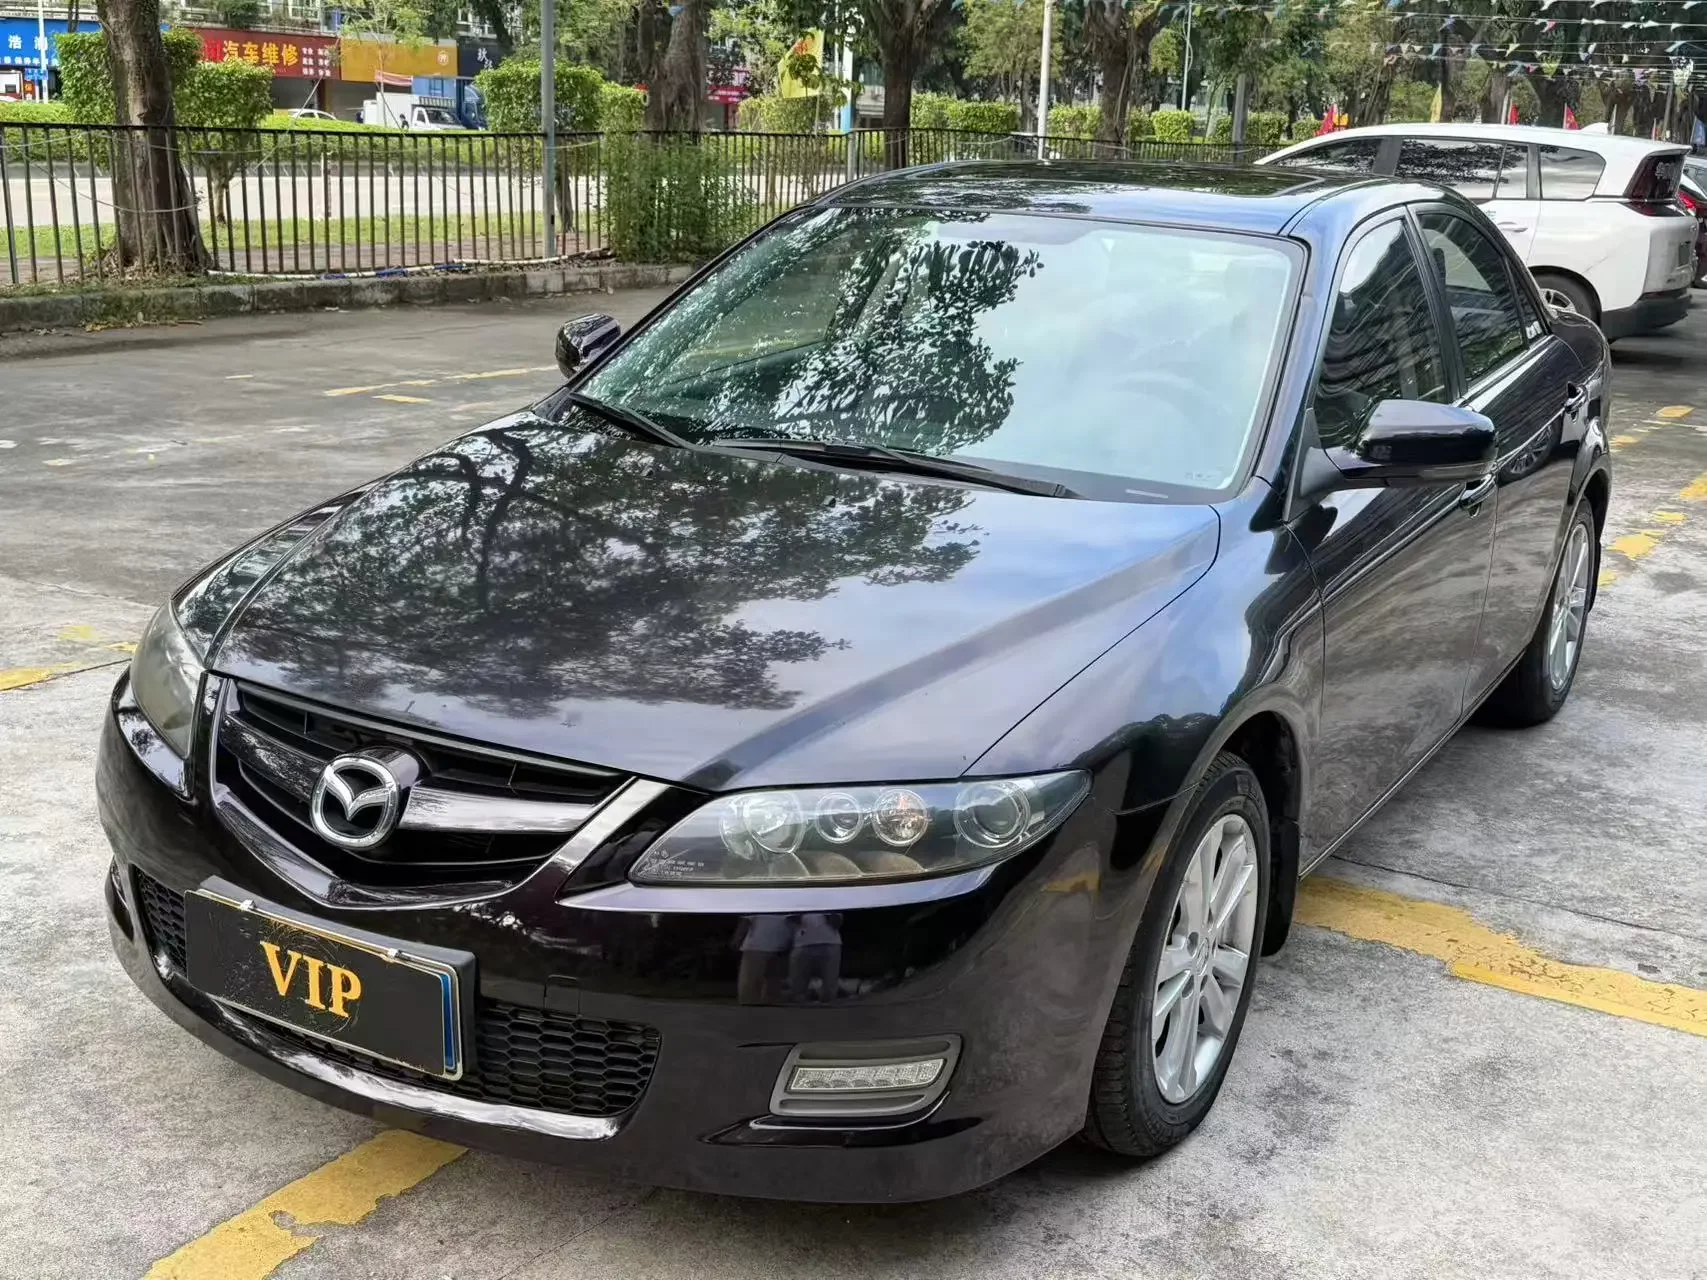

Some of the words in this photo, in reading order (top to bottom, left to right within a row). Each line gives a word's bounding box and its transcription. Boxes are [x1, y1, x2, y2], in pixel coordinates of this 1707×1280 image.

[223, 40, 298, 67] 汽车维修
[259, 940, 363, 1018] VIP
